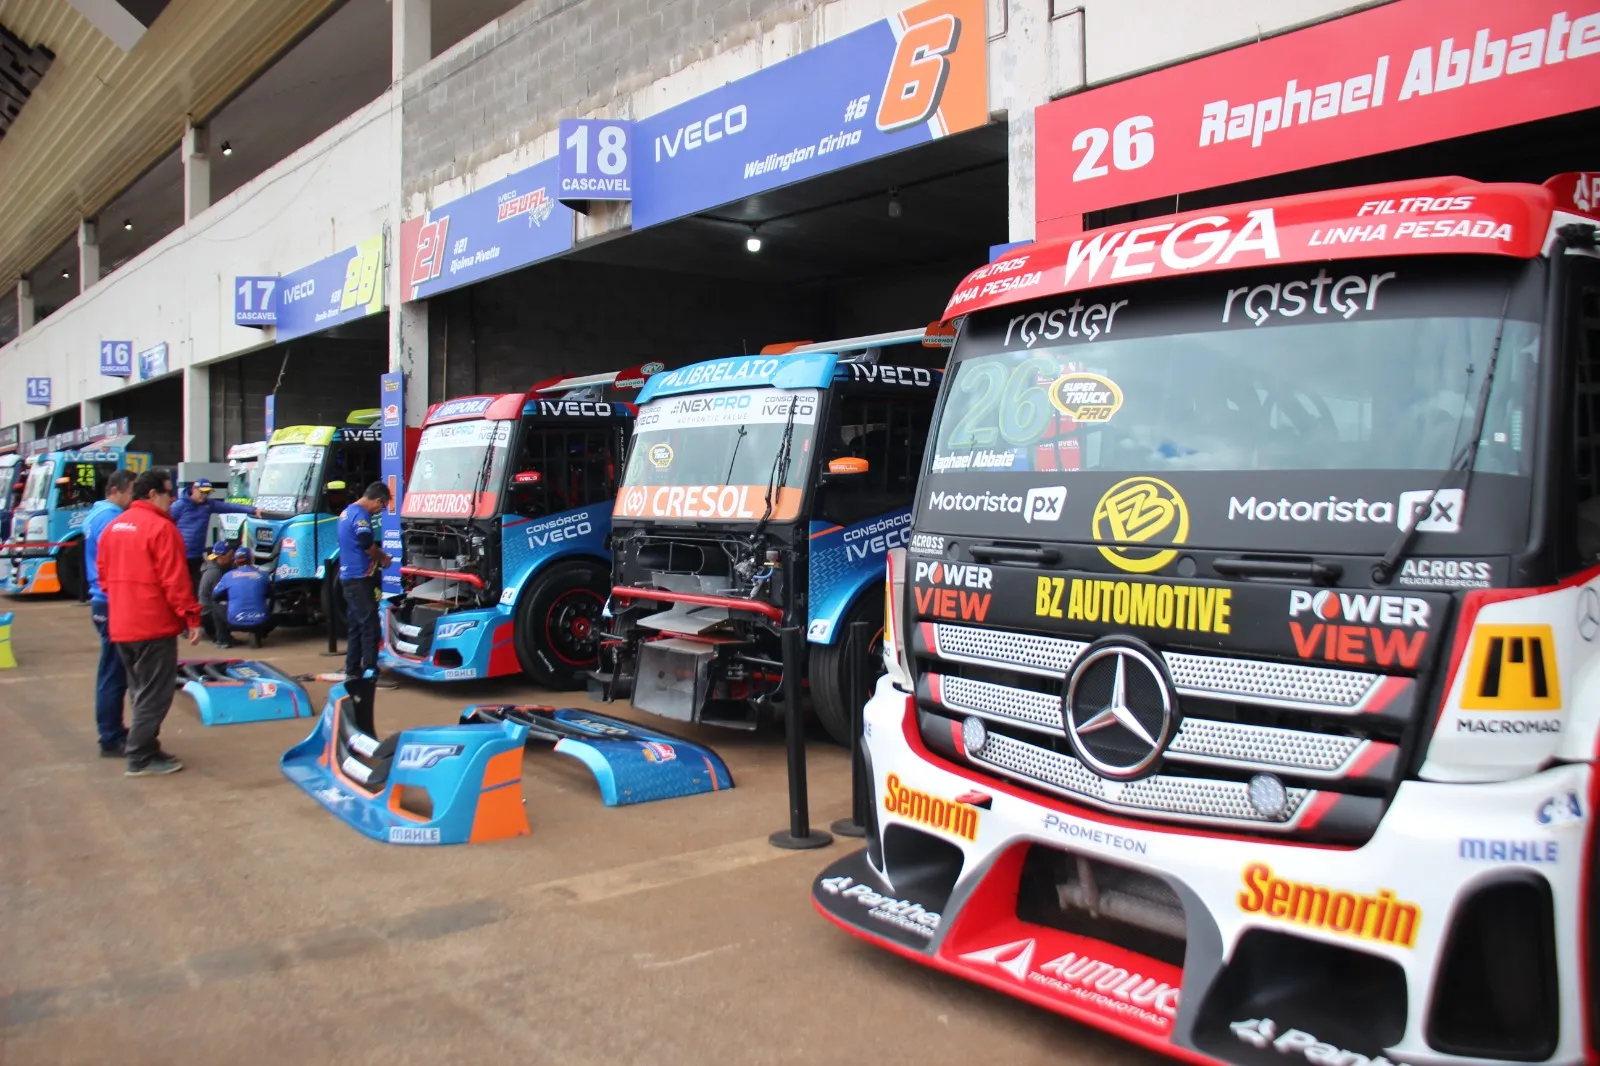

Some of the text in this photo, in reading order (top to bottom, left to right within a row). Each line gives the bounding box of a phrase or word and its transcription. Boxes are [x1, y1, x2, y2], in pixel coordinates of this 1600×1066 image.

[876, 13, 960, 134] 6
[1199, 11, 1600, 148] Raphael Abbate
[844, 95, 871, 123] #6
[655, 104, 748, 163] IVECO
[566, 125, 628, 175] 18
[744, 129, 862, 180] Wellington Cirino
[1072, 115, 1155, 183] 26
[562, 178, 631, 191] CASCAVEL
[1357, 196, 1476, 217] FILTROS
[1308, 220, 1513, 246] LINHA PESADA
[411, 215, 450, 286] 21
[1063, 207, 1281, 288] WEGA
[968, 256, 1030, 284] FILTROS
[238, 280, 276, 310] 17
[284, 279, 315, 305] IVECO
[980, 271, 1043, 299] PESADA
[1222, 268, 1396, 326] raster
[237, 312, 277, 320] CASCAVEL
[1004, 298, 1128, 349] raster
[102, 343, 129, 365] 16
[674, 359, 778, 387] LIBRELATO
[850, 363, 932, 387] IVECO
[1062, 382, 1097, 392] SUPER
[28, 379, 50, 396] 15
[1066, 391, 1112, 404] TRUCK
[540, 401, 612, 417] IVECO
[679, 395, 751, 414] NEXPRO
[722, 413, 749, 421] VALUE
[762, 404, 813, 416] IVECO
[948, 357, 1057, 449] 26
[1077, 407, 1112, 420] PRO
[64, 449, 120, 461] IVECO
[126, 453, 149, 474] 57
[932, 449, 1015, 474] Raphael Abbate
[421, 493, 473, 513] SEGUROS
[652, 486, 754, 518] CRESOL
[929, 490, 1059, 520] Motorista px
[1228, 496, 1393, 523] Motorista
[525, 511, 589, 535] CONSÓRCIO
[528, 520, 592, 549] IVECO
[844, 512, 913, 542] CONSÓRCIO
[911, 534, 945, 549] ACROSS
[915, 561, 992, 589] POWER
[1400, 559, 1492, 579] ACROSS
[1444, 579, 1490, 588] ESPECIAIS
[914, 586, 992, 622] VIEW
[1035, 576, 1233, 634] BZ AUTOMOTIVE
[1289, 589, 1431, 627] POWER
[1289, 621, 1429, 669] VIEW
[1457, 718, 1562, 734] MACROMAQ
[884, 771, 981, 842] Semorin
[391, 828, 439, 843] MAHLE
[1042, 813, 1148, 854] PROMETEON
[1459, 838, 1559, 862] MAHLE
[843, 883, 942, 930] Panthe
[1238, 863, 1421, 949] Semorin
[1027, 970, 1168, 1027] TINTAS AUTOMOTIVAS
